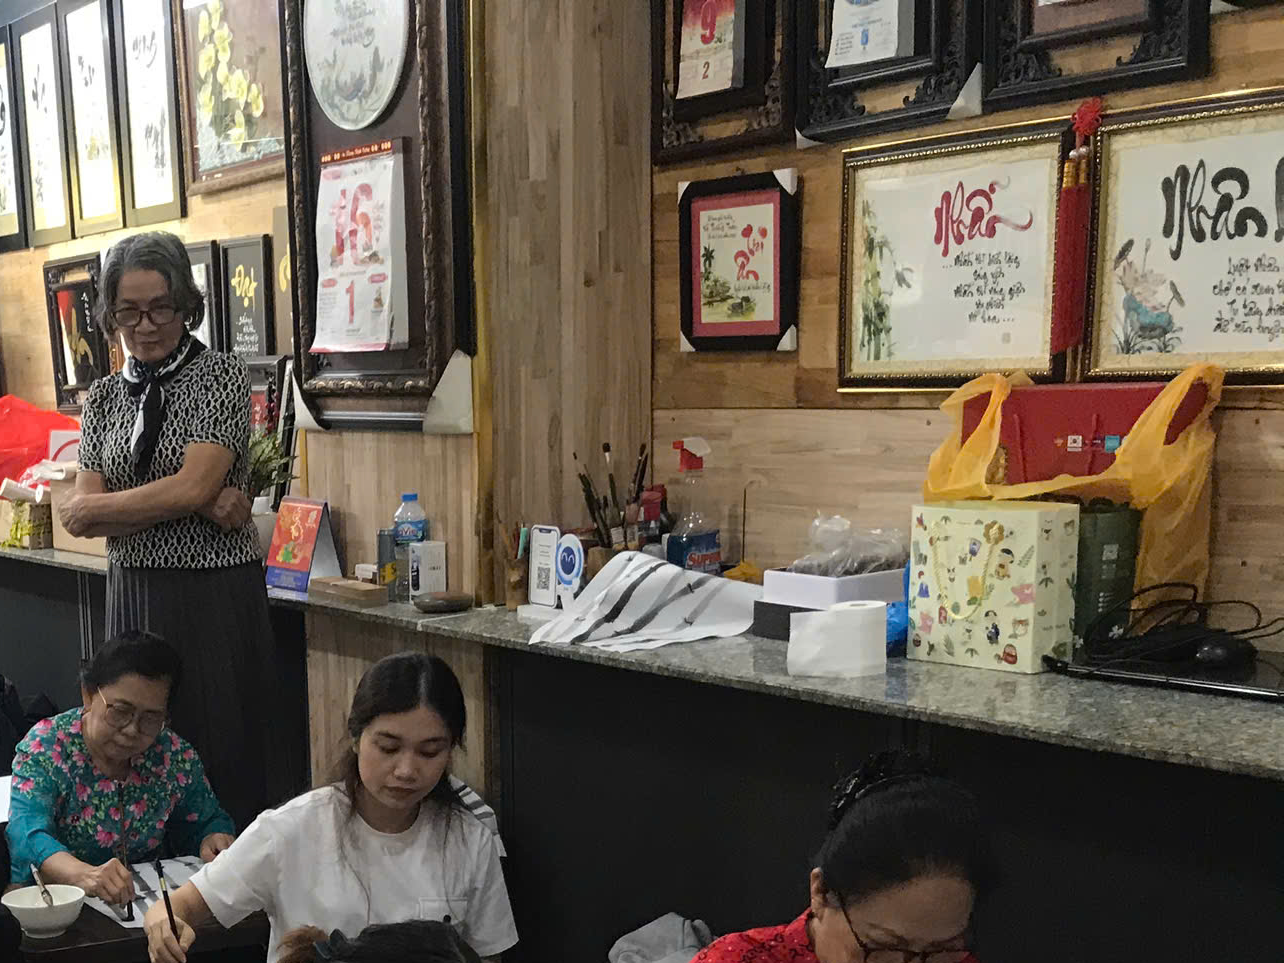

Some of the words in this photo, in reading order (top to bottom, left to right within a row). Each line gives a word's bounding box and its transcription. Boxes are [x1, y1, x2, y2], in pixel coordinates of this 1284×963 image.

[702, 61, 711, 80] 2
[1161, 159, 1268, 261] Nhân
[231, 264, 258, 313] Đạt
[345, 279, 356, 325] 1
